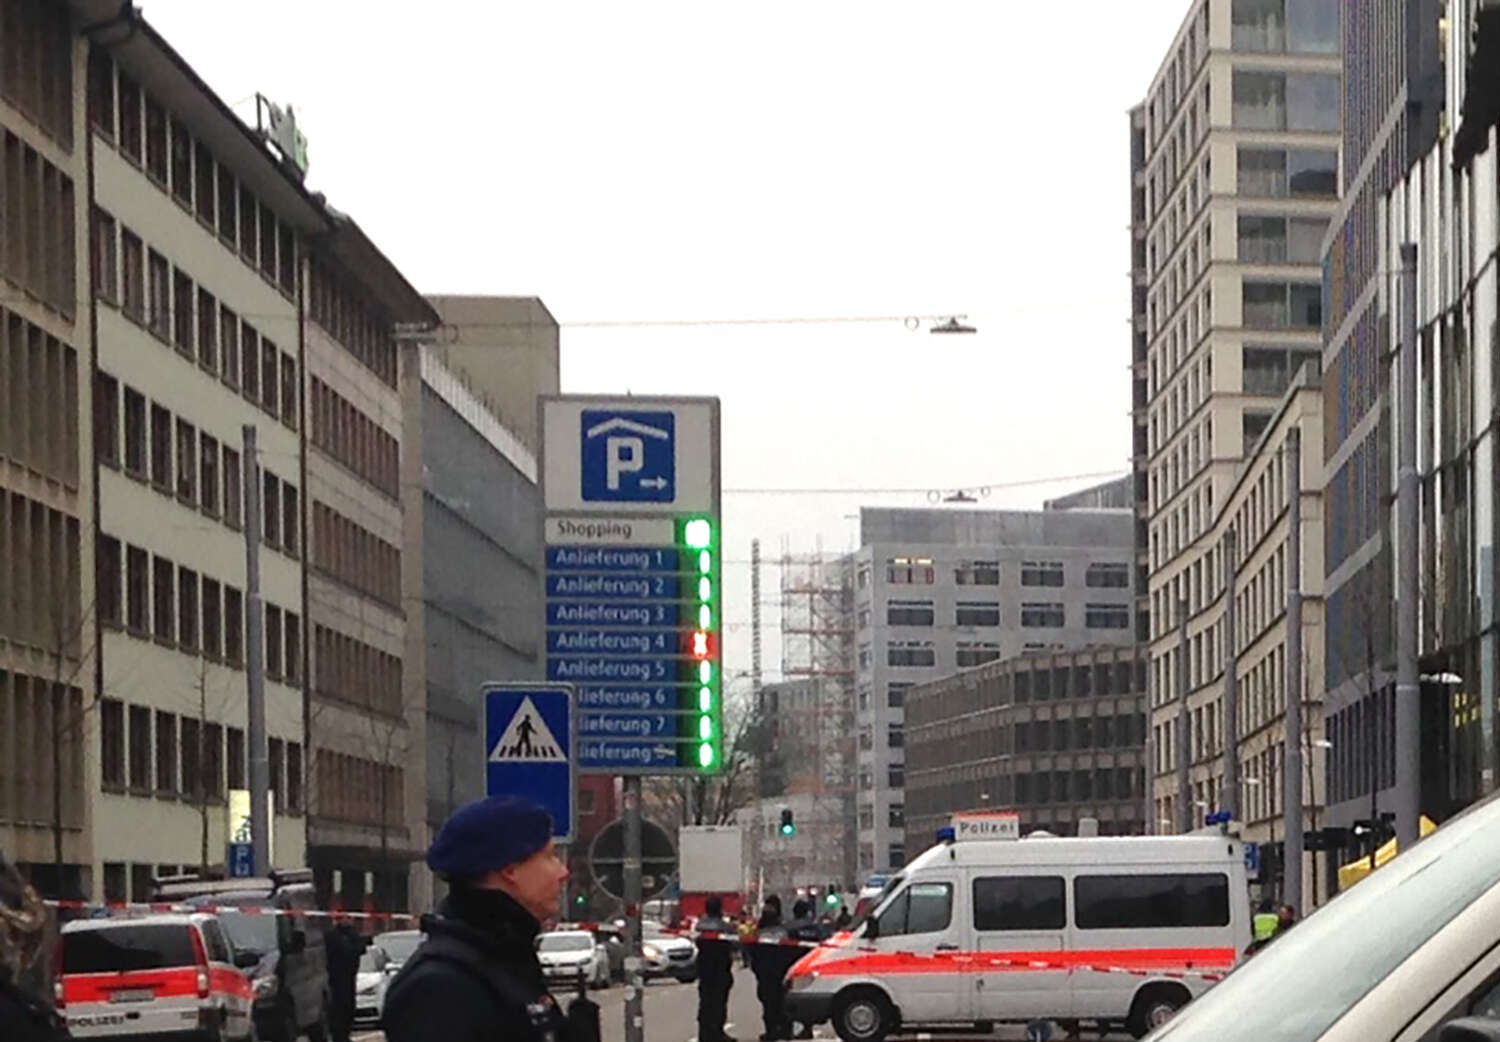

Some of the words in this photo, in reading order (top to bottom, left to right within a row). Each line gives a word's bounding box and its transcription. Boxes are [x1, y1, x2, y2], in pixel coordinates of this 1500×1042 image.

[607, 437, 644, 490] P
[557, 520, 632, 539] Shopping
[556, 549, 650, 569] Anlieferung
[655, 549, 665, 566] 1
[556, 576, 650, 597] Anlieferung
[655, 577, 665, 594] 2
[556, 605, 650, 624] Anlieferung
[655, 605, 665, 621] 3
[556, 632, 650, 652] Anlieferung
[655, 634, 665, 648] 4
[556, 660, 650, 680] Anlieferung
[655, 660, 665, 676] 5
[655, 689, 666, 704] 6
[656, 716, 665, 731] 7
[960, 822, 1014, 833] Polizei
[68, 1016, 124, 1027] POLIZEI
